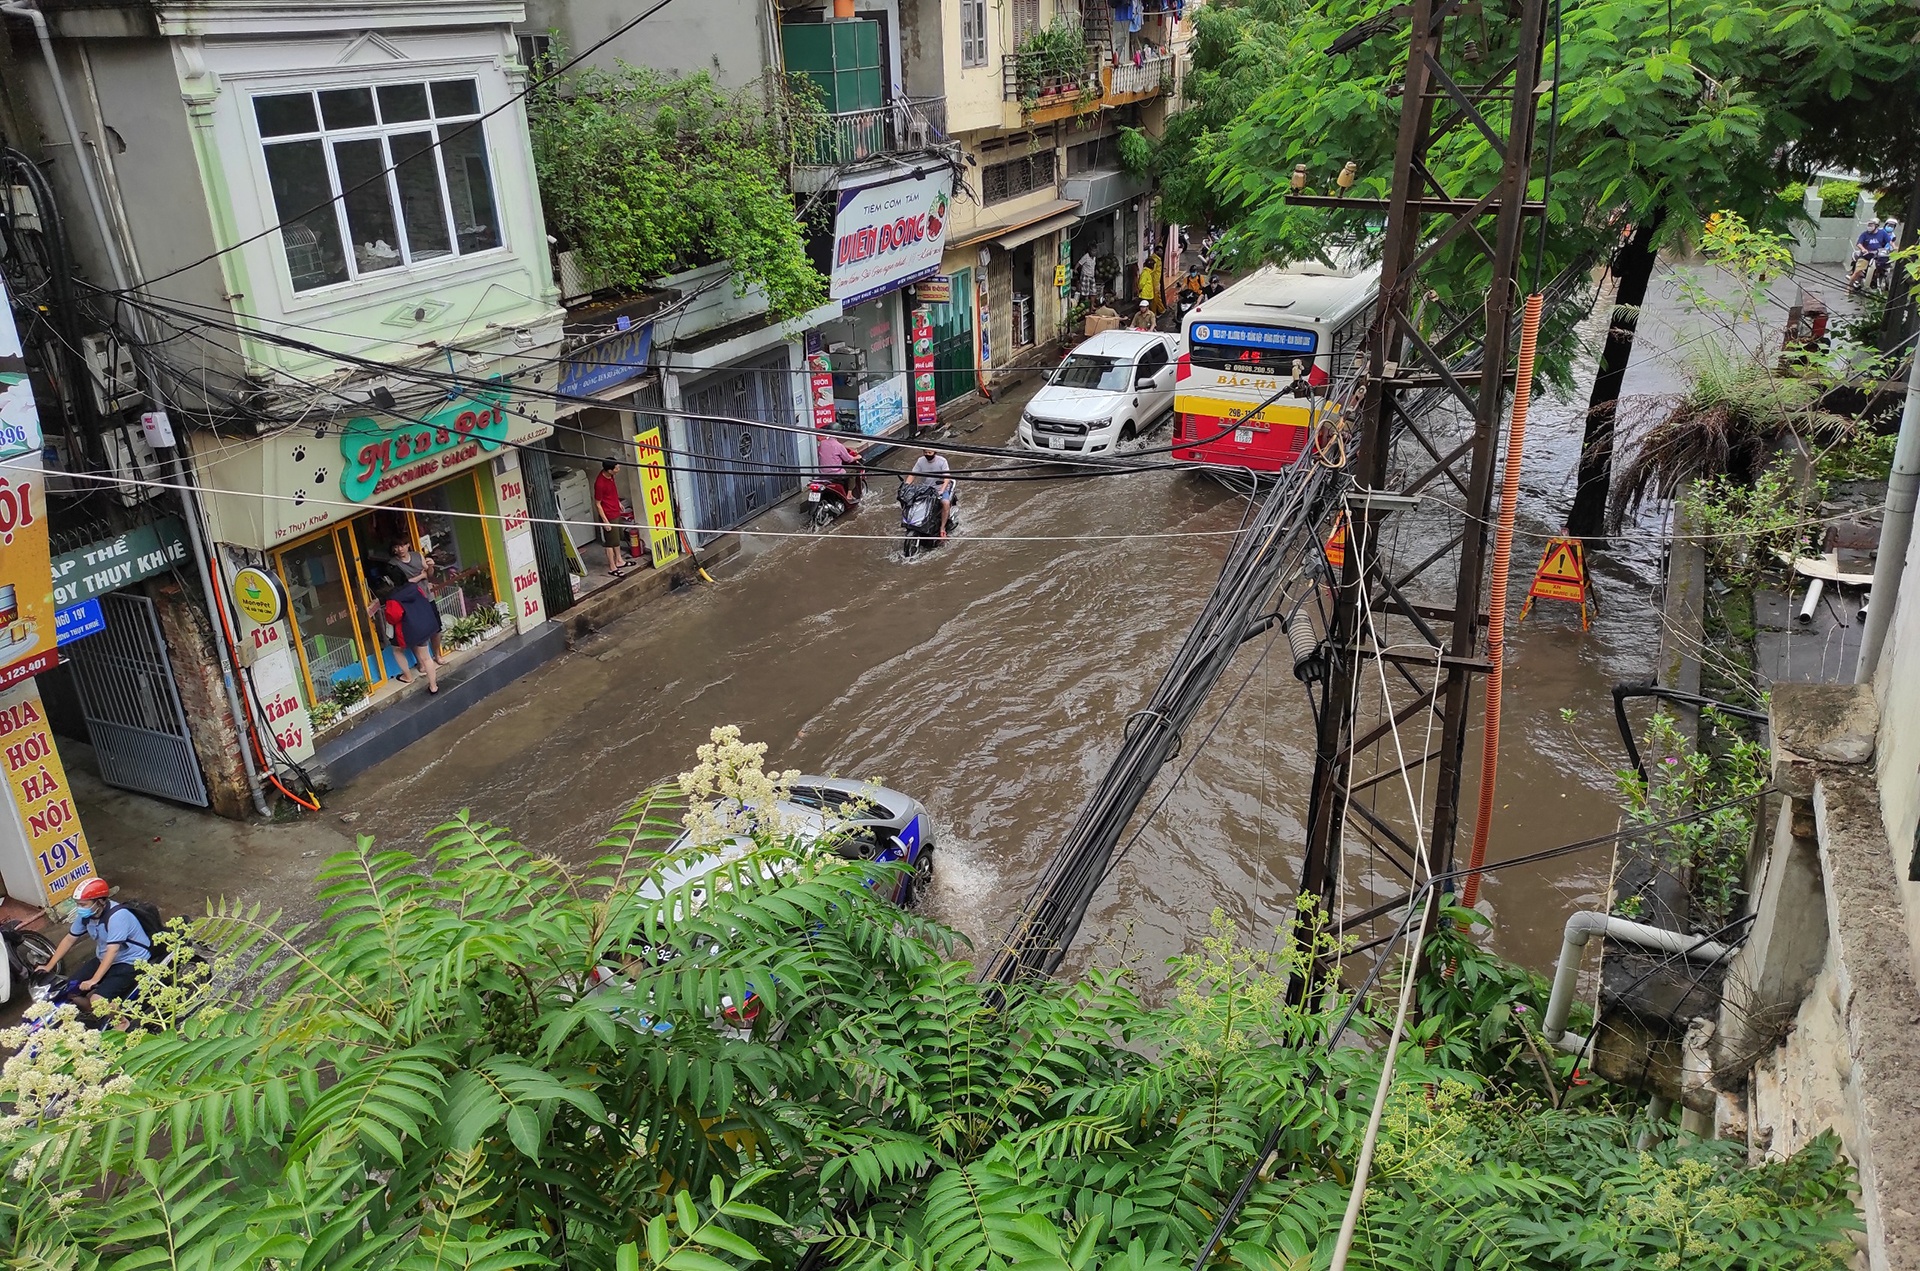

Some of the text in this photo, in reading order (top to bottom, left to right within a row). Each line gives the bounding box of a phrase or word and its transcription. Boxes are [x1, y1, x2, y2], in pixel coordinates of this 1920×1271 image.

[1197, 326, 1208, 338] 45
[1217, 373, 1277, 389] BẮC HÀ
[639, 434, 661, 460] PHO
[373, 444, 478, 495] GROOMING SALON
[500, 481, 522, 501] Phụ
[649, 484, 665, 506] CO
[288, 520, 308, 533] Thụy
[308, 510, 329, 526] Khuê
[504, 508, 529, 532] Kiện
[653, 509, 667, 532] PY
[83, 534, 129, 567] THỂ
[653, 540, 663, 563] IN
[82, 560, 132, 593] THỤY
[136, 538, 187, 574] KHUÊ
[513, 568, 538, 593] Thức
[72, 606, 86, 621] 19Y
[524, 595, 539, 618] Ăn
[85, 618, 100, 631] KHUÊ
[0, 700, 40, 736] BIA
[265, 693, 299, 723] Tắm
[275, 722, 304, 752] Sấy
[6, 731, 52, 771] HƠI
[21, 764, 59, 803] HÀ
[28, 799, 73, 838] NỘI
[38, 833, 84, 876] 19Y
[68, 860, 91, 884] KHUÊ
